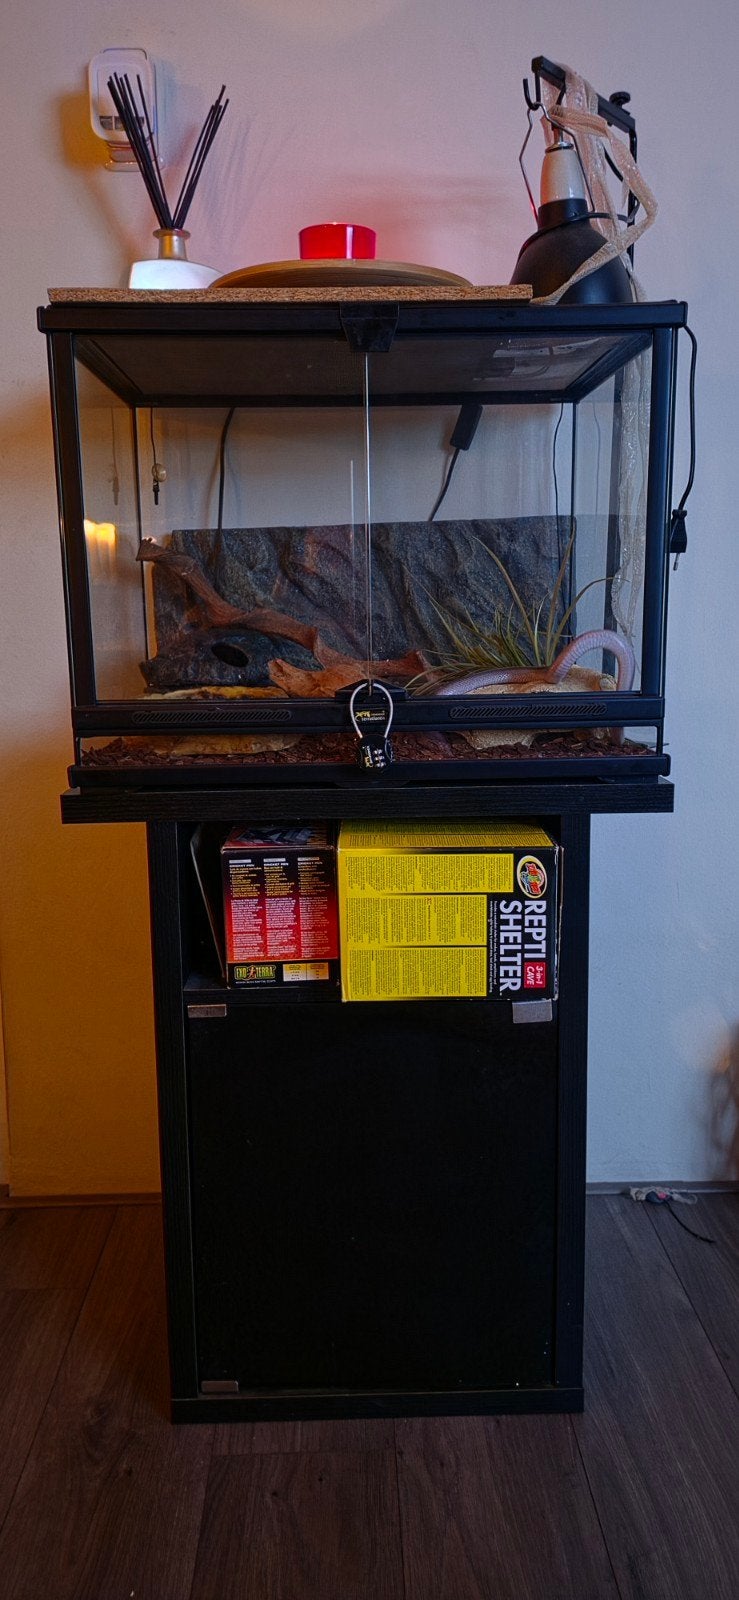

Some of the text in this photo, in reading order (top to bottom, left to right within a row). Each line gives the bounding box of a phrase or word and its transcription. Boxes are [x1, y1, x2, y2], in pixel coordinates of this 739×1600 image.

[524, 900, 547, 959] REPTI
[499, 899, 522, 992] SHELTER
[255, 966, 274, 978] TERRA
[526, 965, 535, 986] CAVE
[535, 965, 543, 985] 3-in-1
